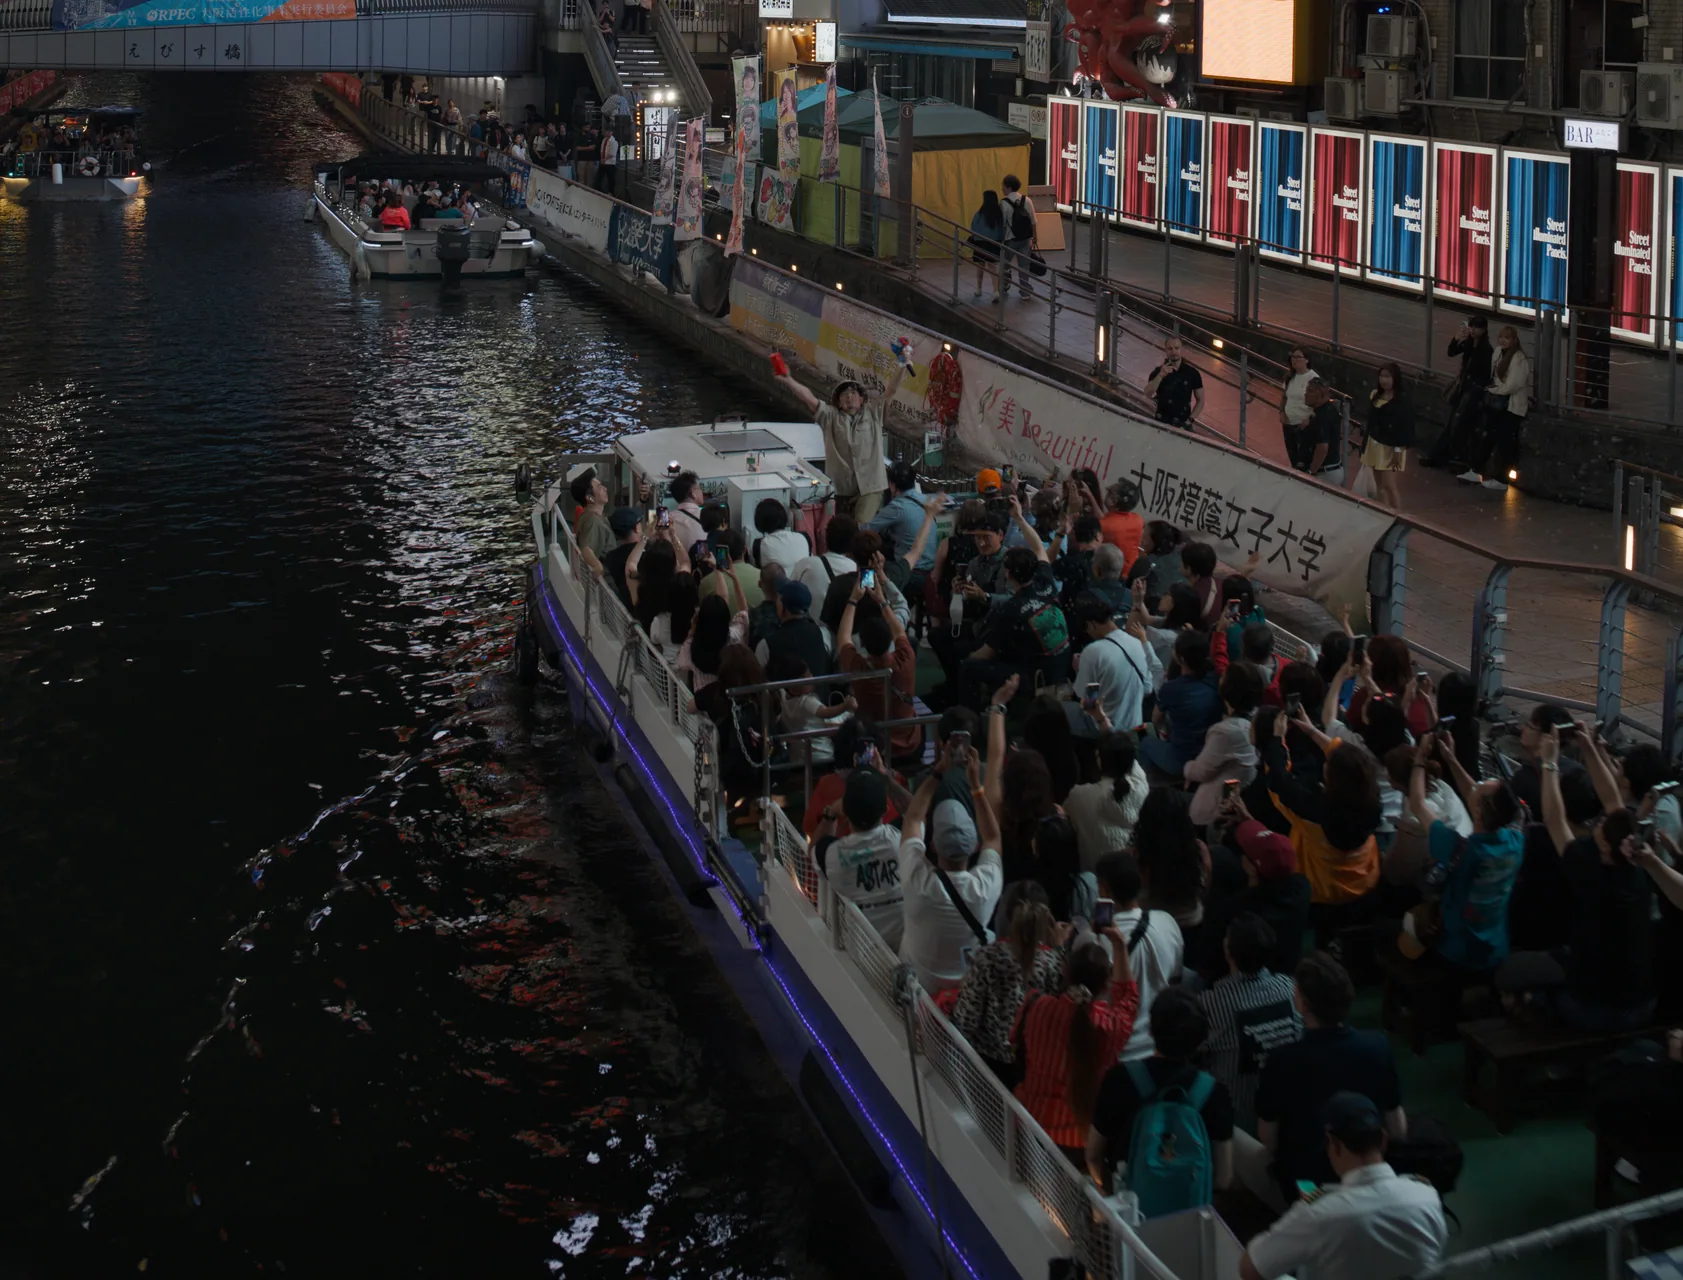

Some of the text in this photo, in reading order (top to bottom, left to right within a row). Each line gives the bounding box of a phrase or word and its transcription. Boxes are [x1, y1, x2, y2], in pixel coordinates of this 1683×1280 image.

[128, 42, 241, 61] えびす橋
[1566, 125, 1594, 144] BAR
[1405, 194, 1420, 209] Street
[1472, 205, 1489, 220] Street
[1546, 217, 1565, 233] Street
[1629, 230, 1650, 247] Street
[1614, 240, 1651, 260] illuminated
[996, 397, 1016, 436] 美
[1021, 407, 1113, 481] Beautiful
[1129, 462, 1327, 582] 大阪樟蔭女子大学
